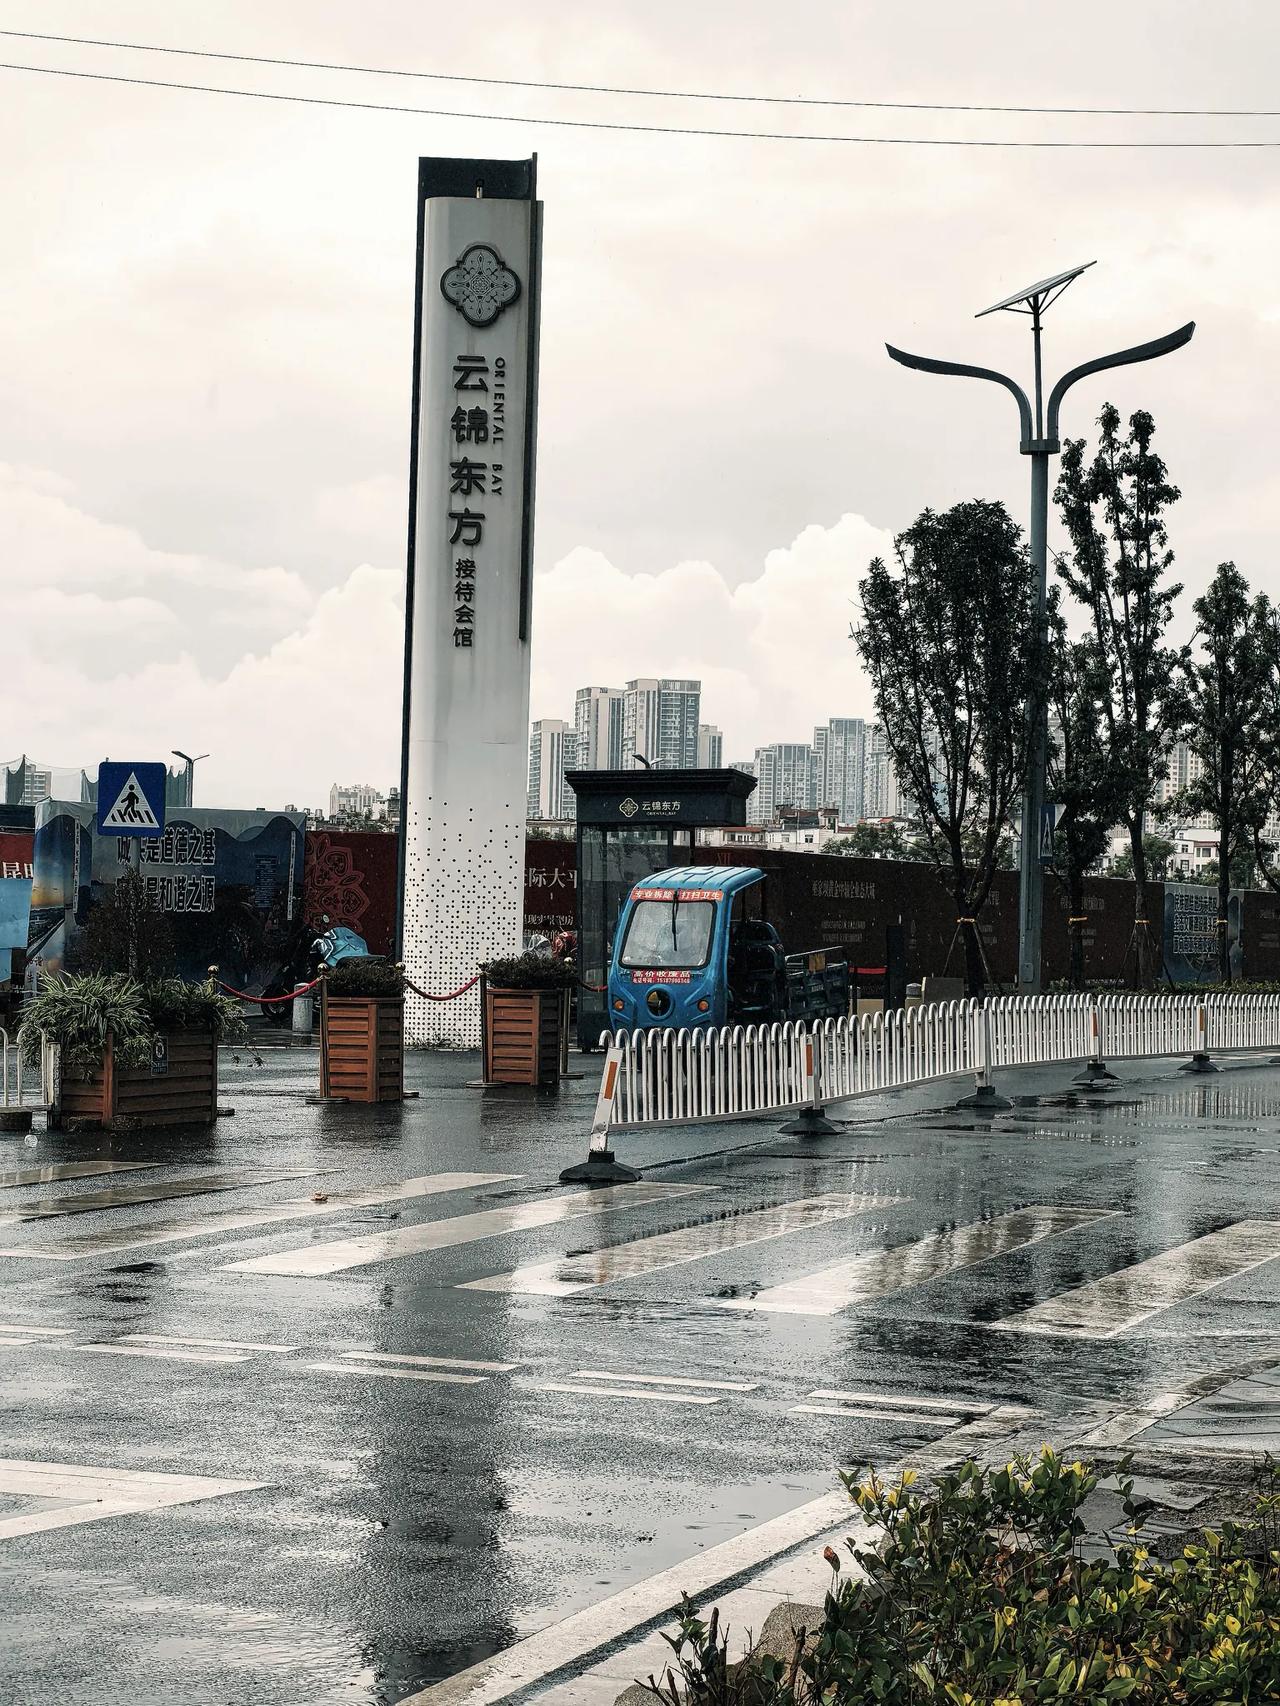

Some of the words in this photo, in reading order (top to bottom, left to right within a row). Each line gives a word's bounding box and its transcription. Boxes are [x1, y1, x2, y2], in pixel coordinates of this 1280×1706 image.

[492, 357, 506, 445] ORIENTAL
[448, 355, 489, 546] 云锦东方
[491, 464, 503, 496] BAY
[453, 558, 476, 647] 接待会馆
[642, 800, 681, 811] 云锦东方
[635, 890, 673, 899] 专业拆除
[681, 891, 720, 900] 打扫卫生
